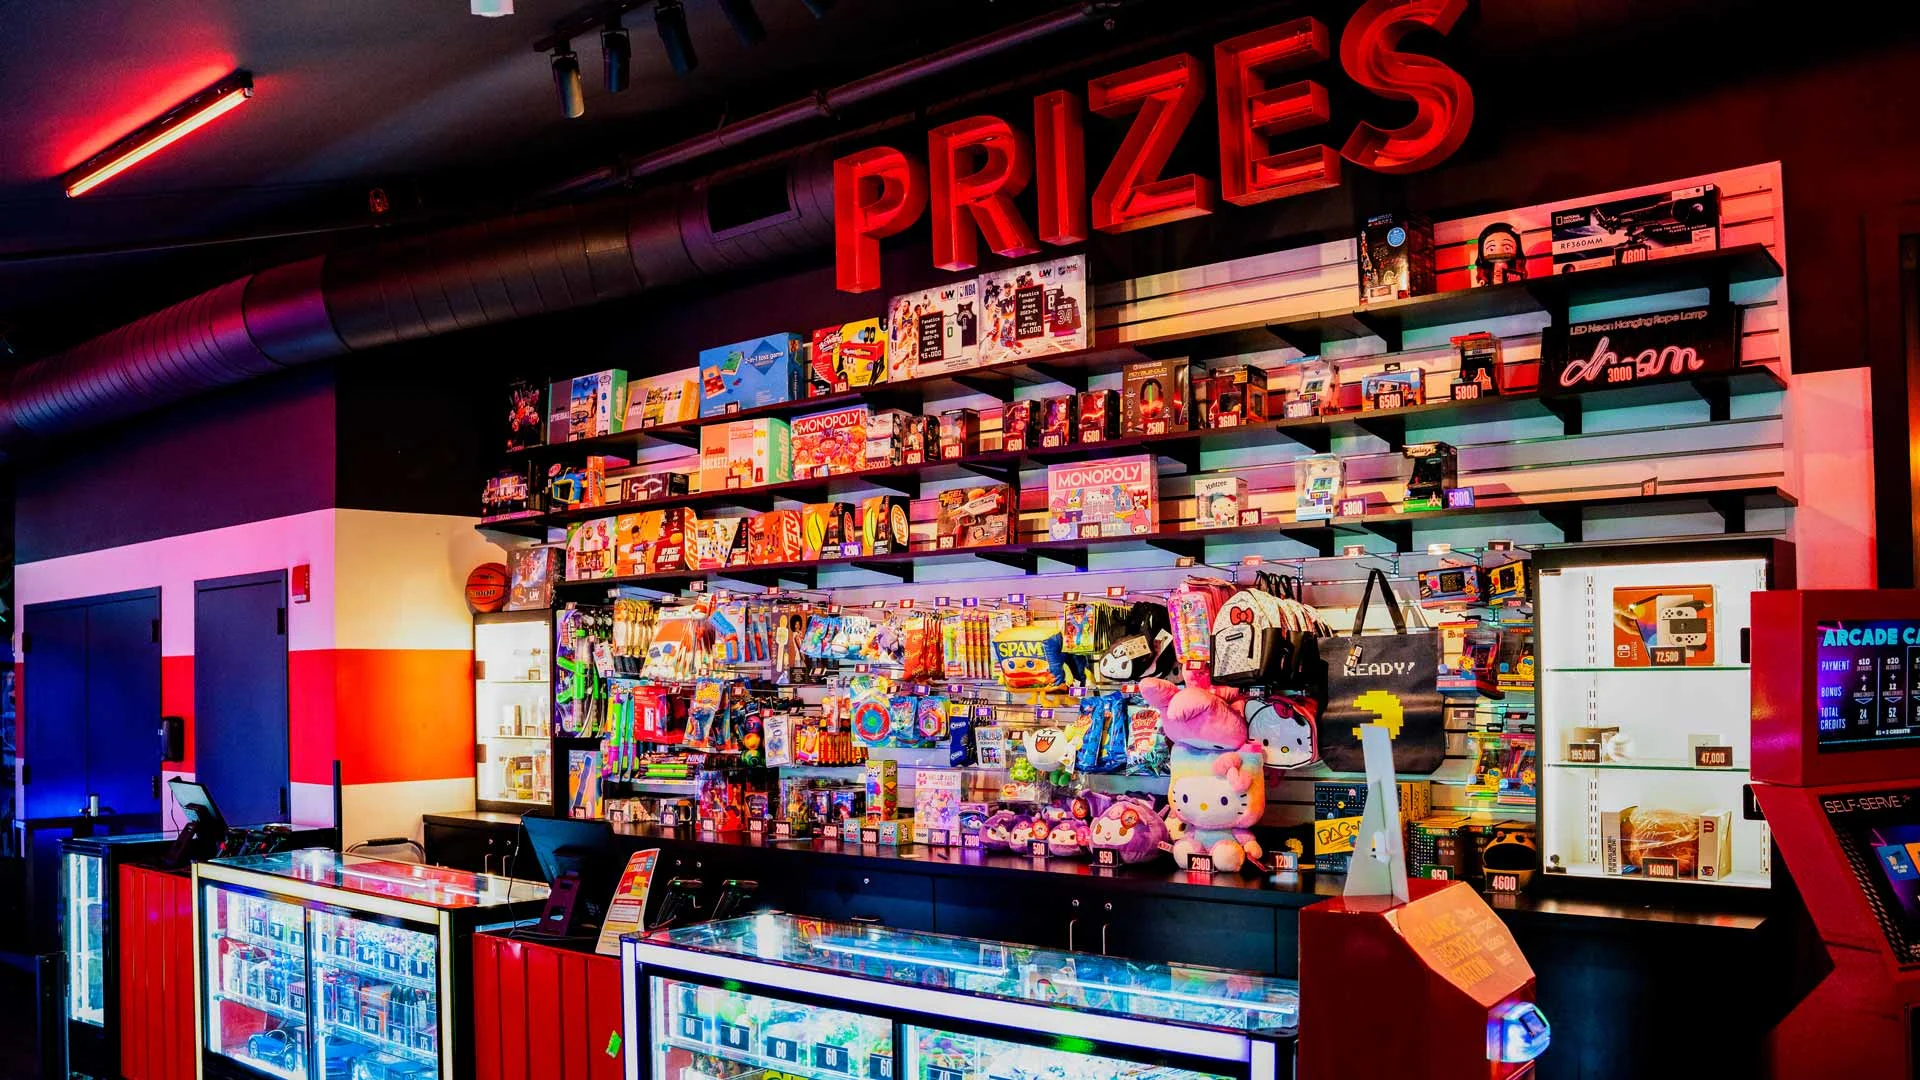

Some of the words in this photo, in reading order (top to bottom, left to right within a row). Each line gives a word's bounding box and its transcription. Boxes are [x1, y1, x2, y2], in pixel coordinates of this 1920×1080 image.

[833, 0, 1475, 294] PRIZES
[1560, 237, 1603, 250] RF360MM
[1570, 326, 1588, 336] LED
[1588, 322, 1614, 334] Neon
[1614, 316, 1653, 330] Hanging
[1653, 314, 1680, 326] Rope
[1680, 310, 1708, 321] Lamp
[770, 352, 784, 360] game
[1560, 336, 1704, 387] dram
[1607, 365, 1632, 383] 3000
[1455, 384, 1478, 400] 5800
[1378, 394, 1401, 409] 6500
[800, 408, 860, 434] MONOPOLY
[1218, 414, 1237, 428] 3600
[1146, 421, 1165, 436] 2500
[1042, 434, 1059, 448] 4500
[1082, 430, 1100, 443] 4500
[944, 446, 960, 458] 4500
[1007, 438, 1022, 452] 4500
[906, 452, 921, 464] 4500
[1058, 464, 1140, 488] MONOPOLY
[1448, 490, 1470, 507] 5800
[1081, 524, 1098, 538] 4900
[1822, 628, 1898, 647] ARCADE
[998, 641, 1044, 658] SPAM
[1821, 660, 1850, 672] PAYMENT
[1821, 686, 1842, 698] BONUS
[1821, 707, 1838, 718] TOTAL
[1860, 708, 1867, 720] 24
[1888, 706, 1896, 718] 52
[1820, 718, 1846, 730] CREDITS
[1700, 752, 1725, 765] 47,000
[1824, 795, 1902, 814] SELF-SERVE
[1032, 842, 1045, 856] 500
[1098, 851, 1113, 864] 950
[1648, 864, 1674, 877] 140000
[1492, 874, 1516, 892] 4600
[826, 1048, 838, 1067] 60
[880, 1059, 892, 1078] 60
